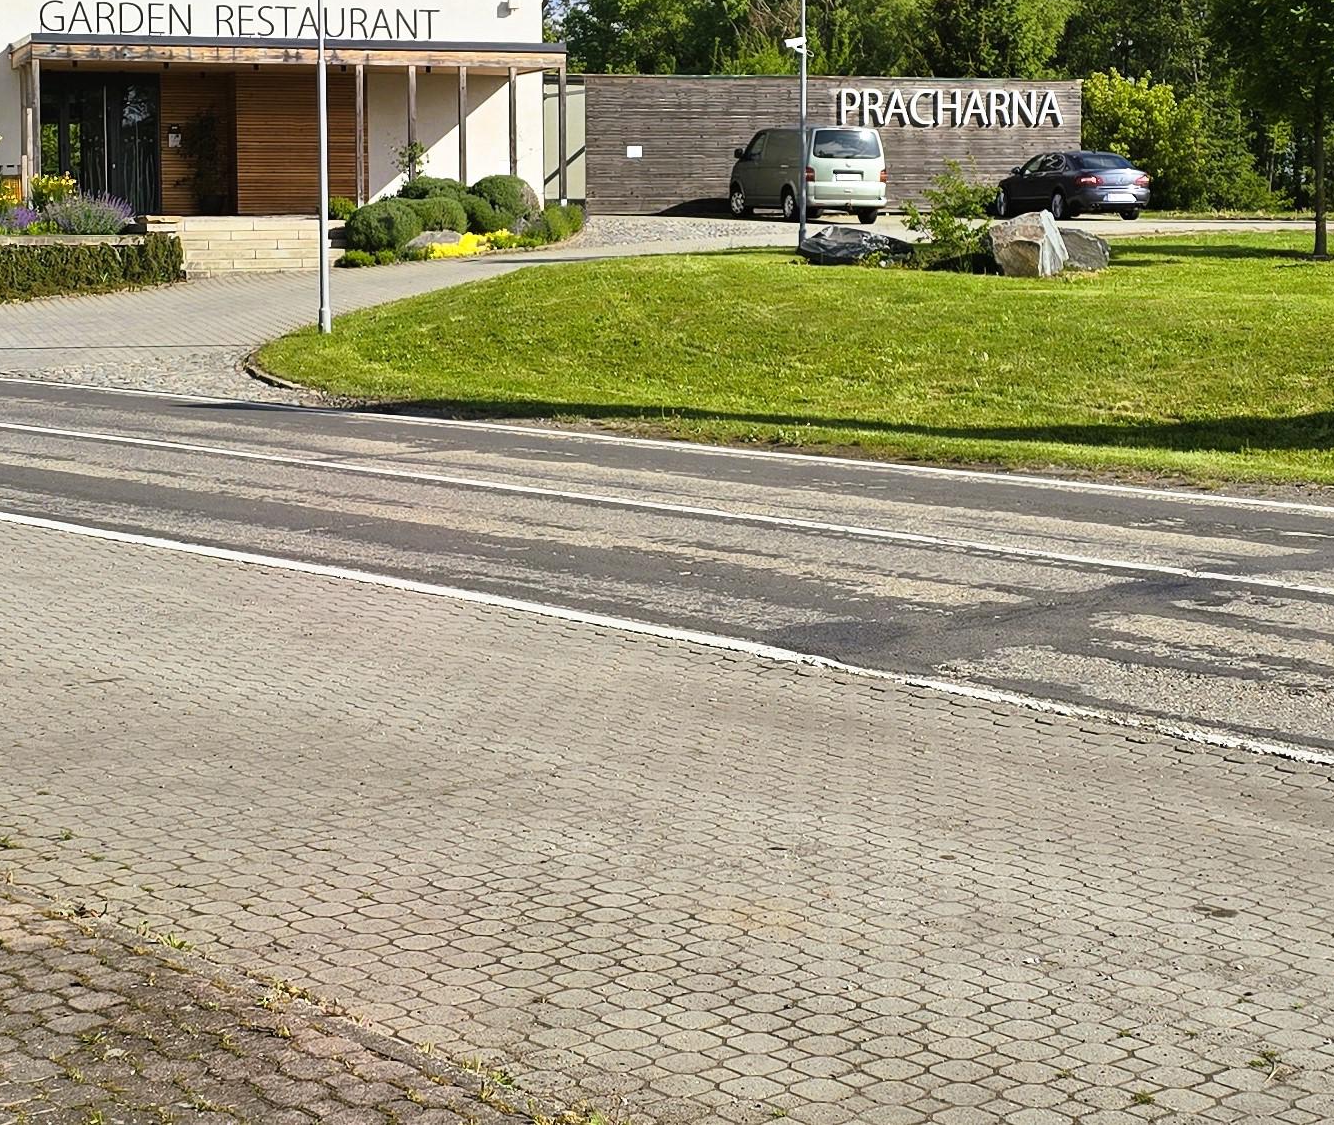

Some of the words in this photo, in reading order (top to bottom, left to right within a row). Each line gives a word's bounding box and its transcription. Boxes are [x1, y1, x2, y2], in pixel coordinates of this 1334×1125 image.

[39, 0, 192, 35] GARDEN
[216, 4, 440, 40] RESTAURANT
[839, 88, 1064, 127] PRACHARNA
